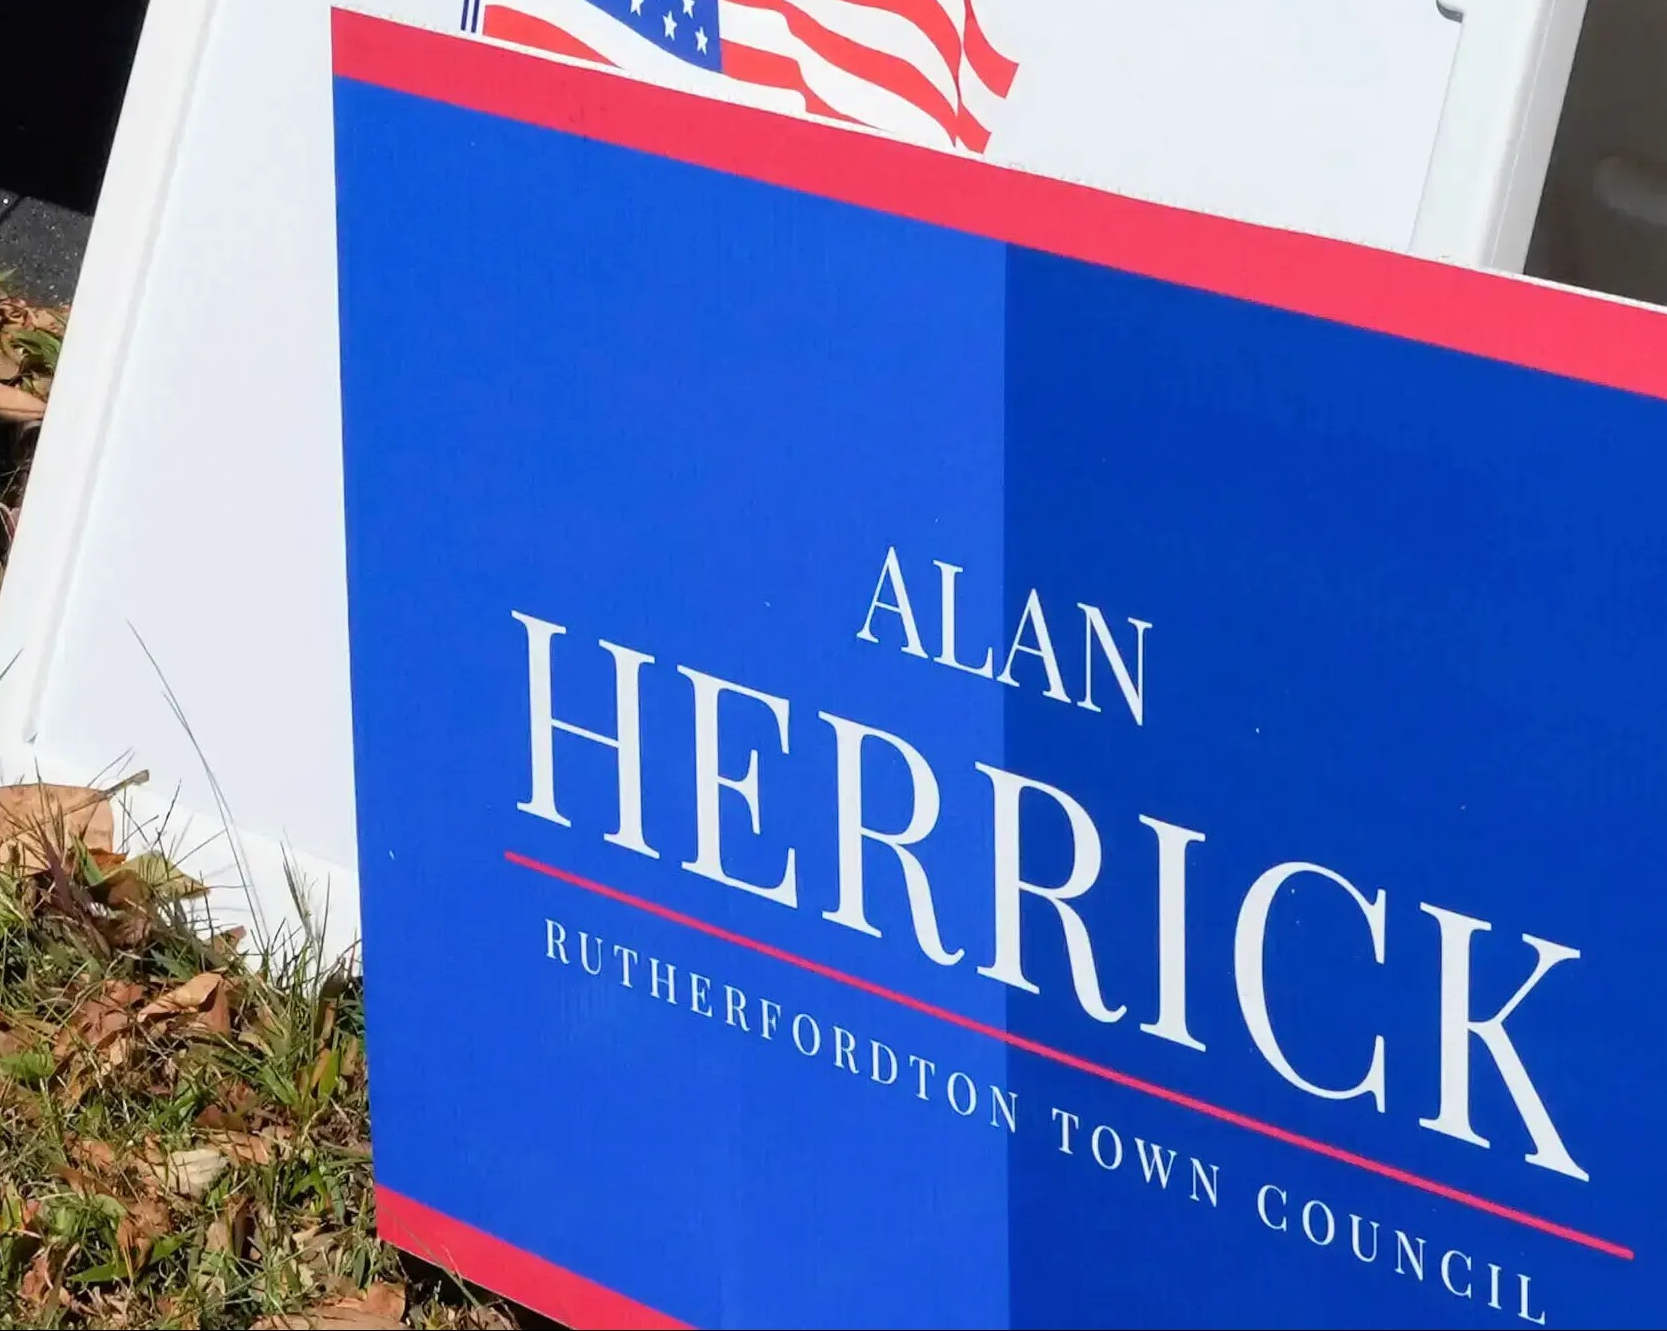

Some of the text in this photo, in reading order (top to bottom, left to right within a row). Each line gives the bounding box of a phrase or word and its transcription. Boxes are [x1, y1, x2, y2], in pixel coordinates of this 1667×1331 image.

[857, 545, 1152, 727] ALAN
[509, 609, 1591, 1185] HERRICK
[544, 917, 1547, 1327] RUTHERFORDTON TOWN COUNCIL
